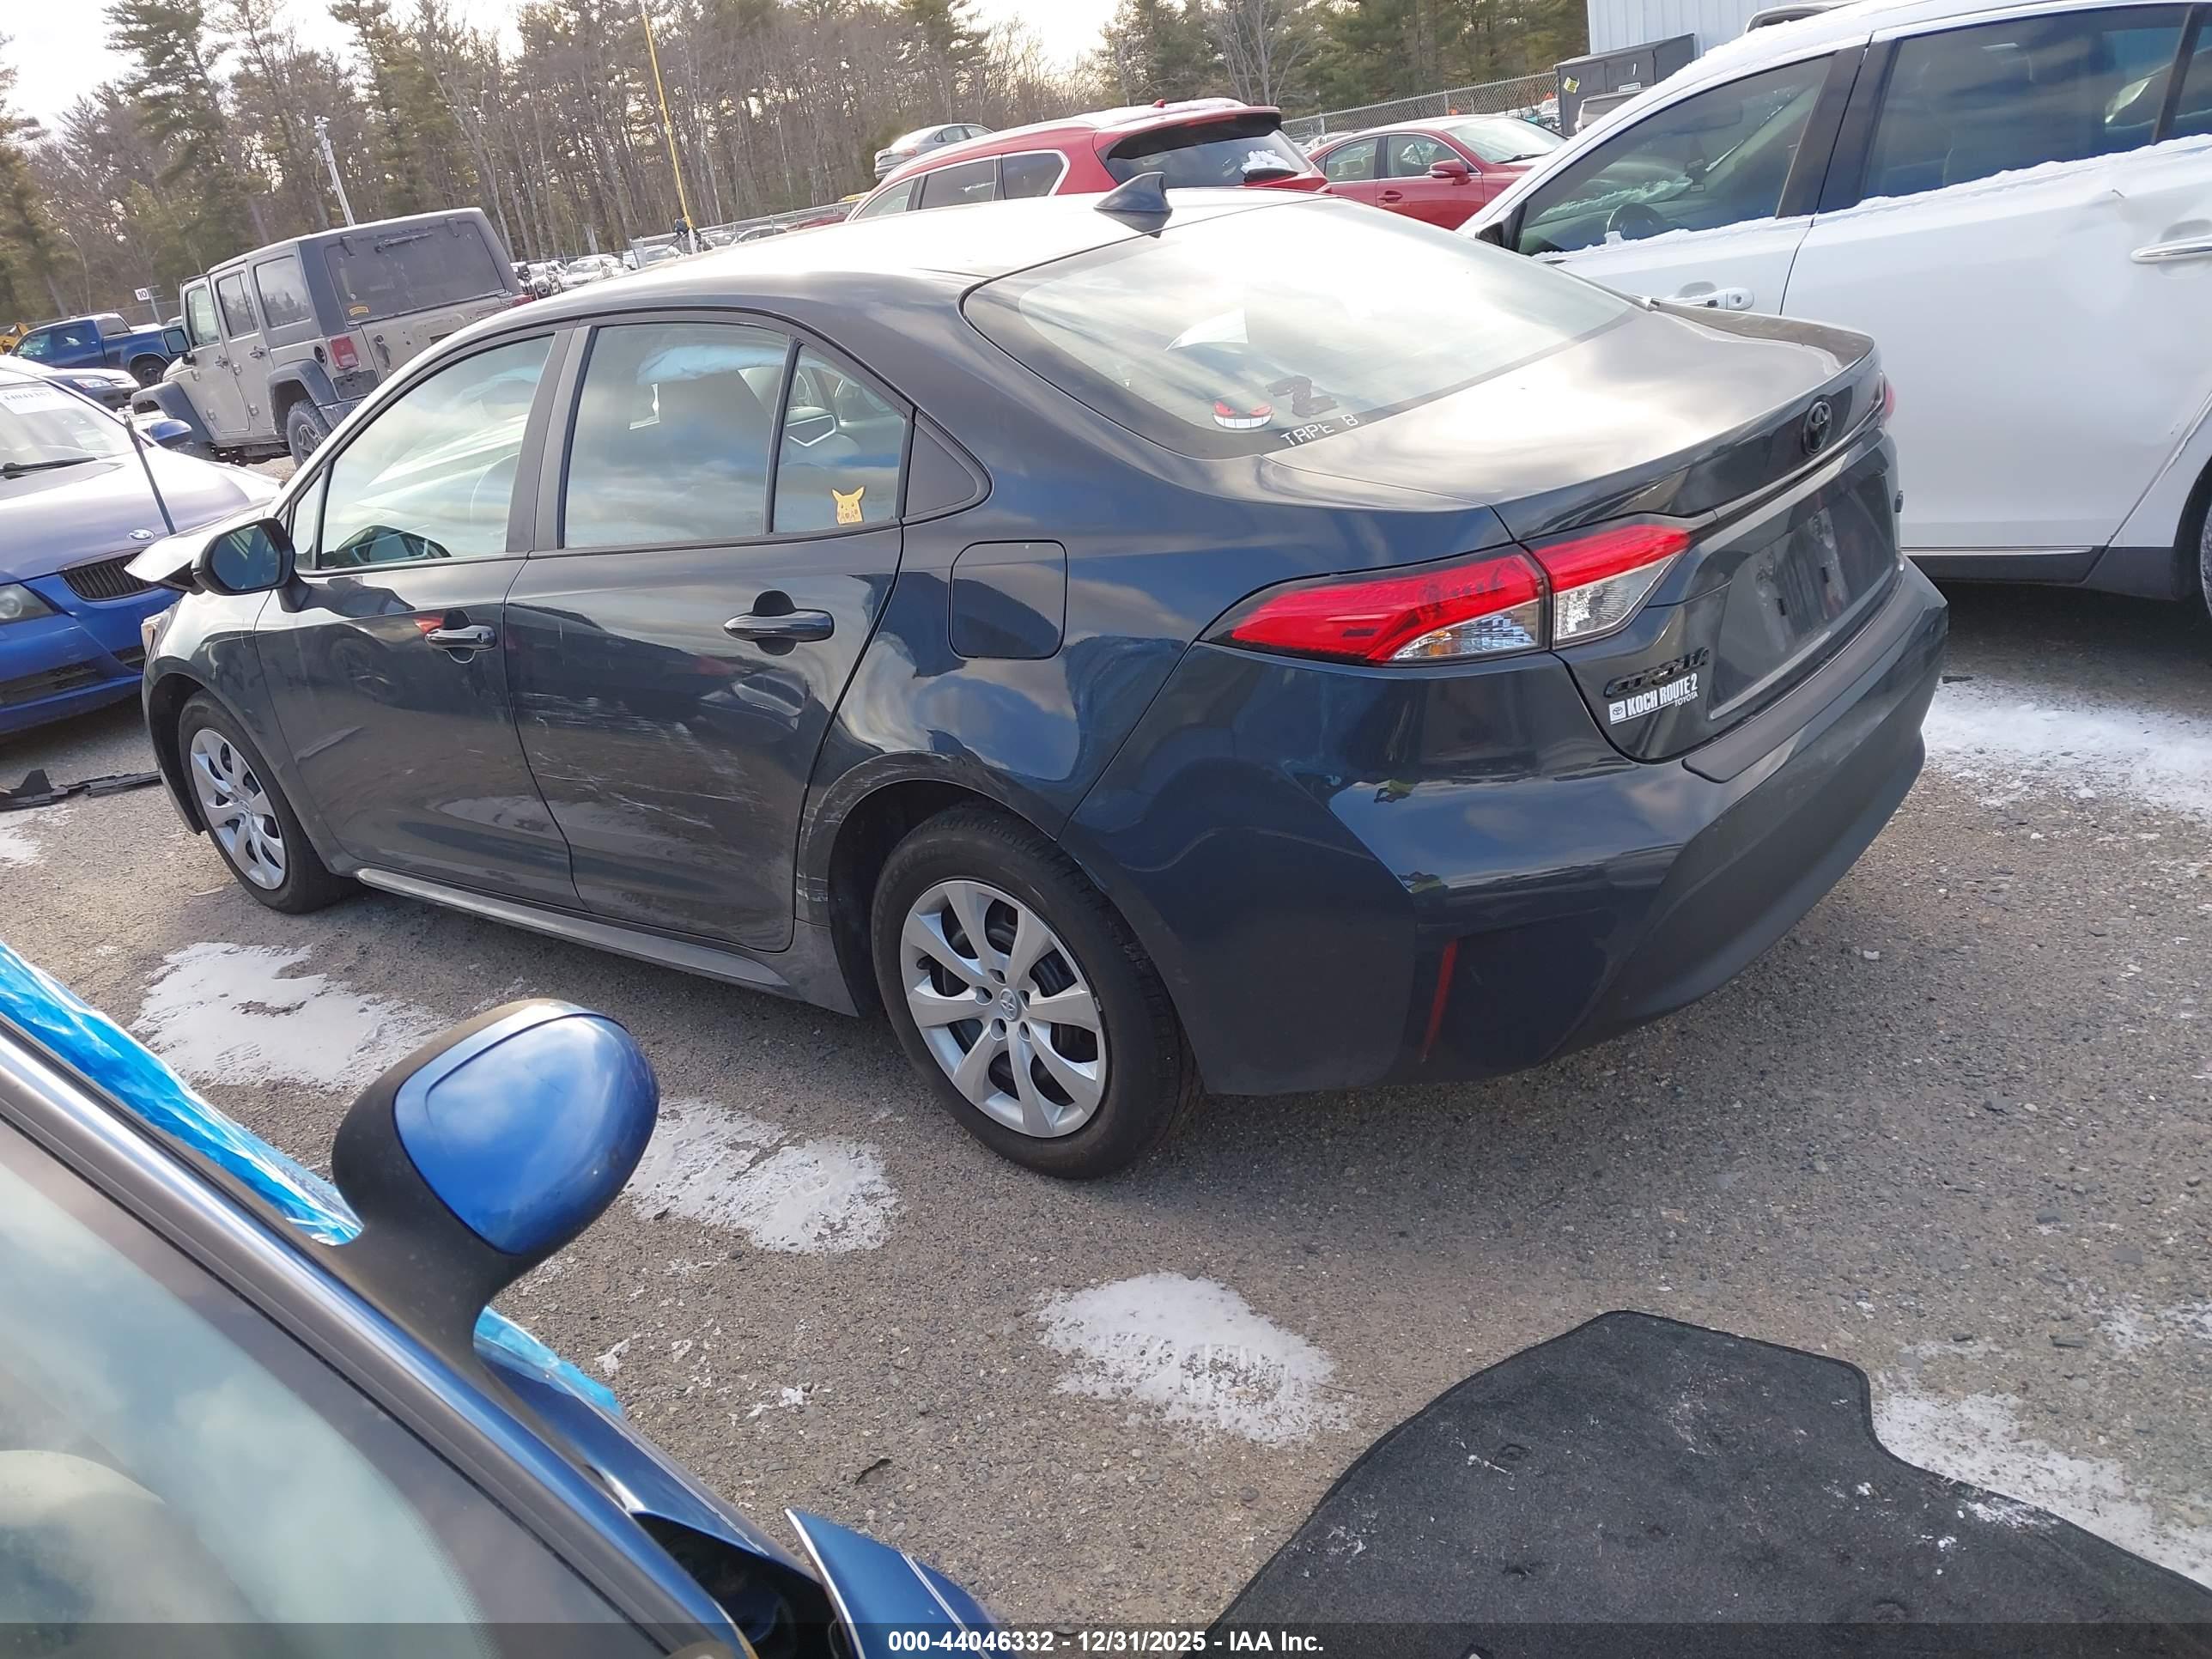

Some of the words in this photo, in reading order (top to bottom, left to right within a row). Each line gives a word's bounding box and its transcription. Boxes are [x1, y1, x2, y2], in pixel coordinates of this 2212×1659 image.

[137, 290, 147, 299] 10
[1626, 690, 1658, 717] KOCH
[1659, 676, 1691, 705] ROUTE
[1690, 672, 1698, 691] 2
[1674, 690, 1699, 708] TOYOTA
